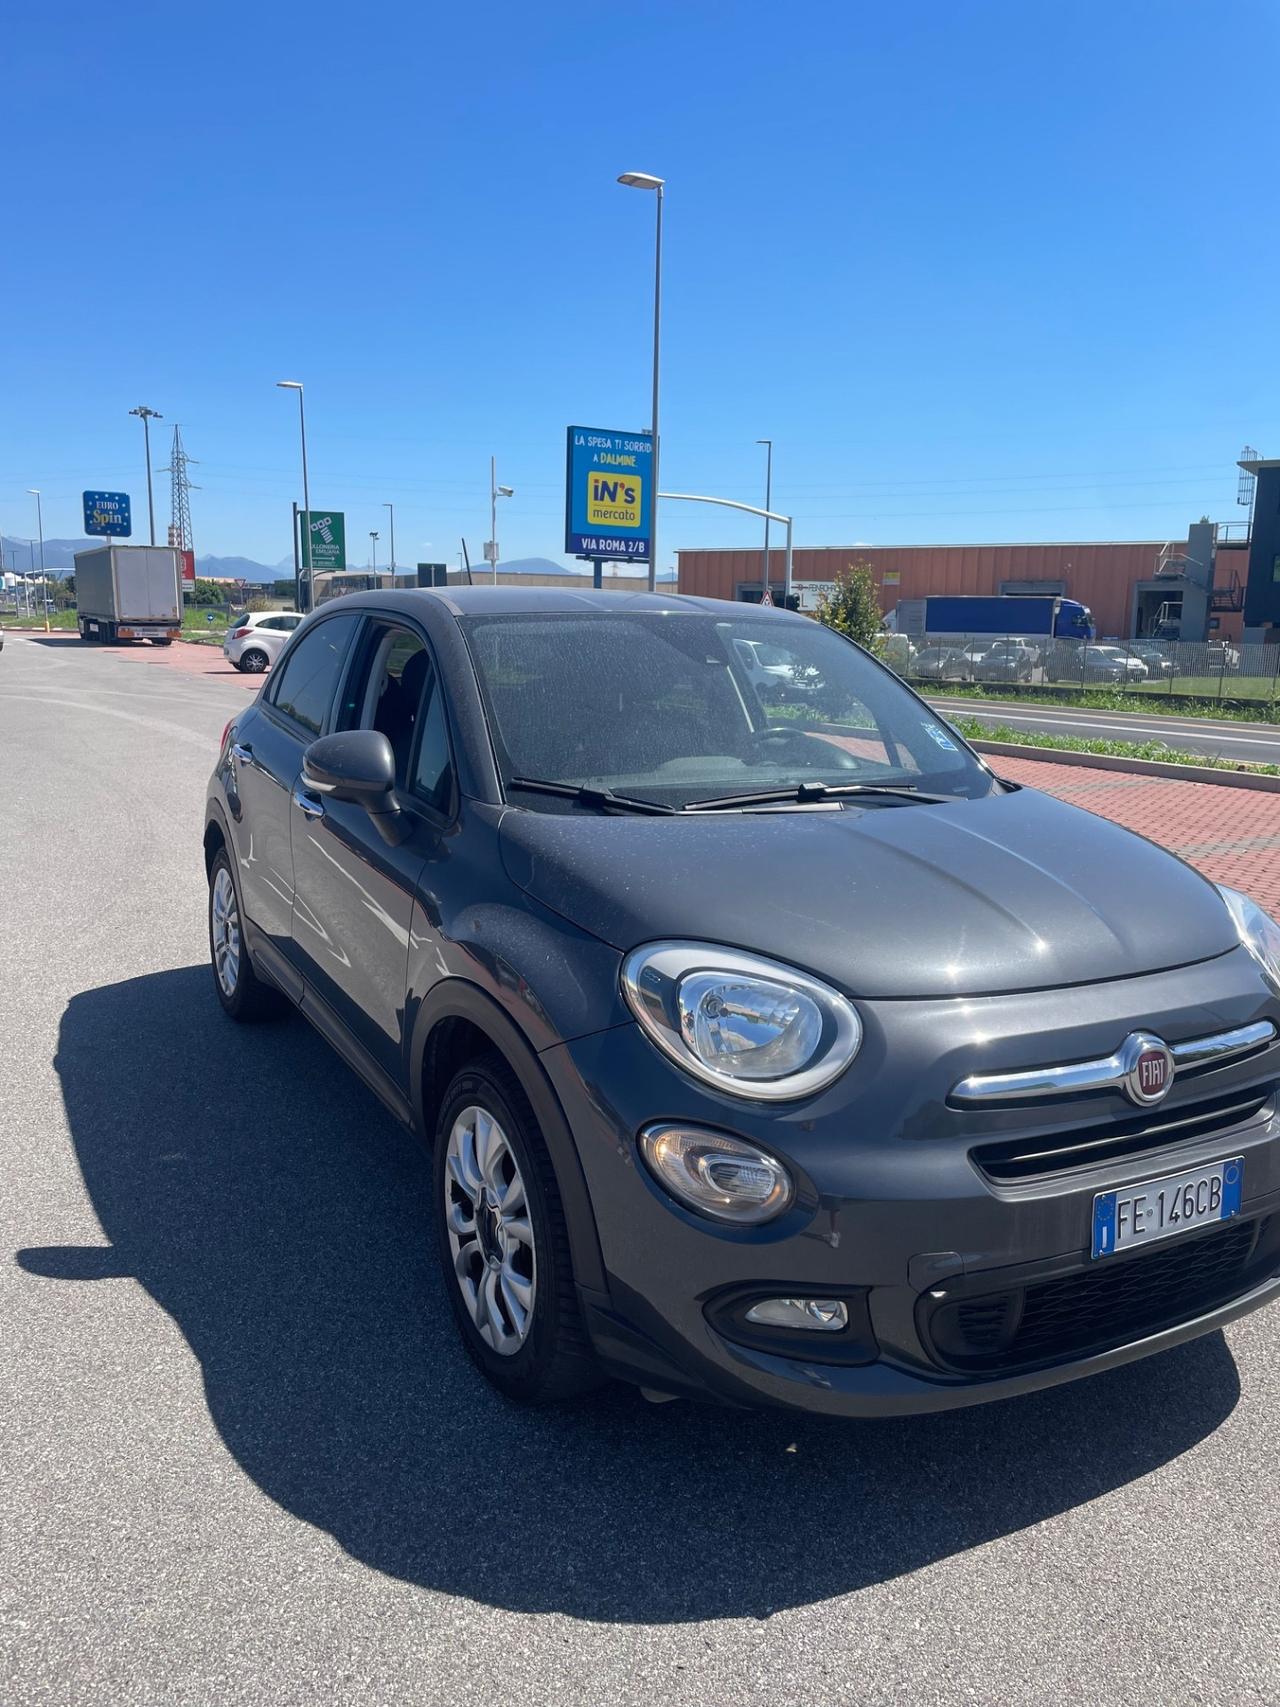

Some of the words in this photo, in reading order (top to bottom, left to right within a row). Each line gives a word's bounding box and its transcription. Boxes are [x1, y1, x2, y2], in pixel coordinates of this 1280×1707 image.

[575, 435, 585, 446] LA
[588, 436, 612, 449] SPESA
[615, 439, 622, 449] TI
[624, 441, 653, 453] SORRID
[593, 454, 599, 463] A
[600, 453, 637, 467] DALMINE
[96, 501, 119, 510] EURO
[93, 508, 122, 527] Spin
[593, 509, 636, 521] mercato
[581, 538, 597, 550] VIA
[600, 539, 626, 552] ROMA
[629, 541, 645, 553] 2/B
[1141, 1058, 1165, 1087] FIAT
[1158, 1174, 1222, 1228] 146CB
